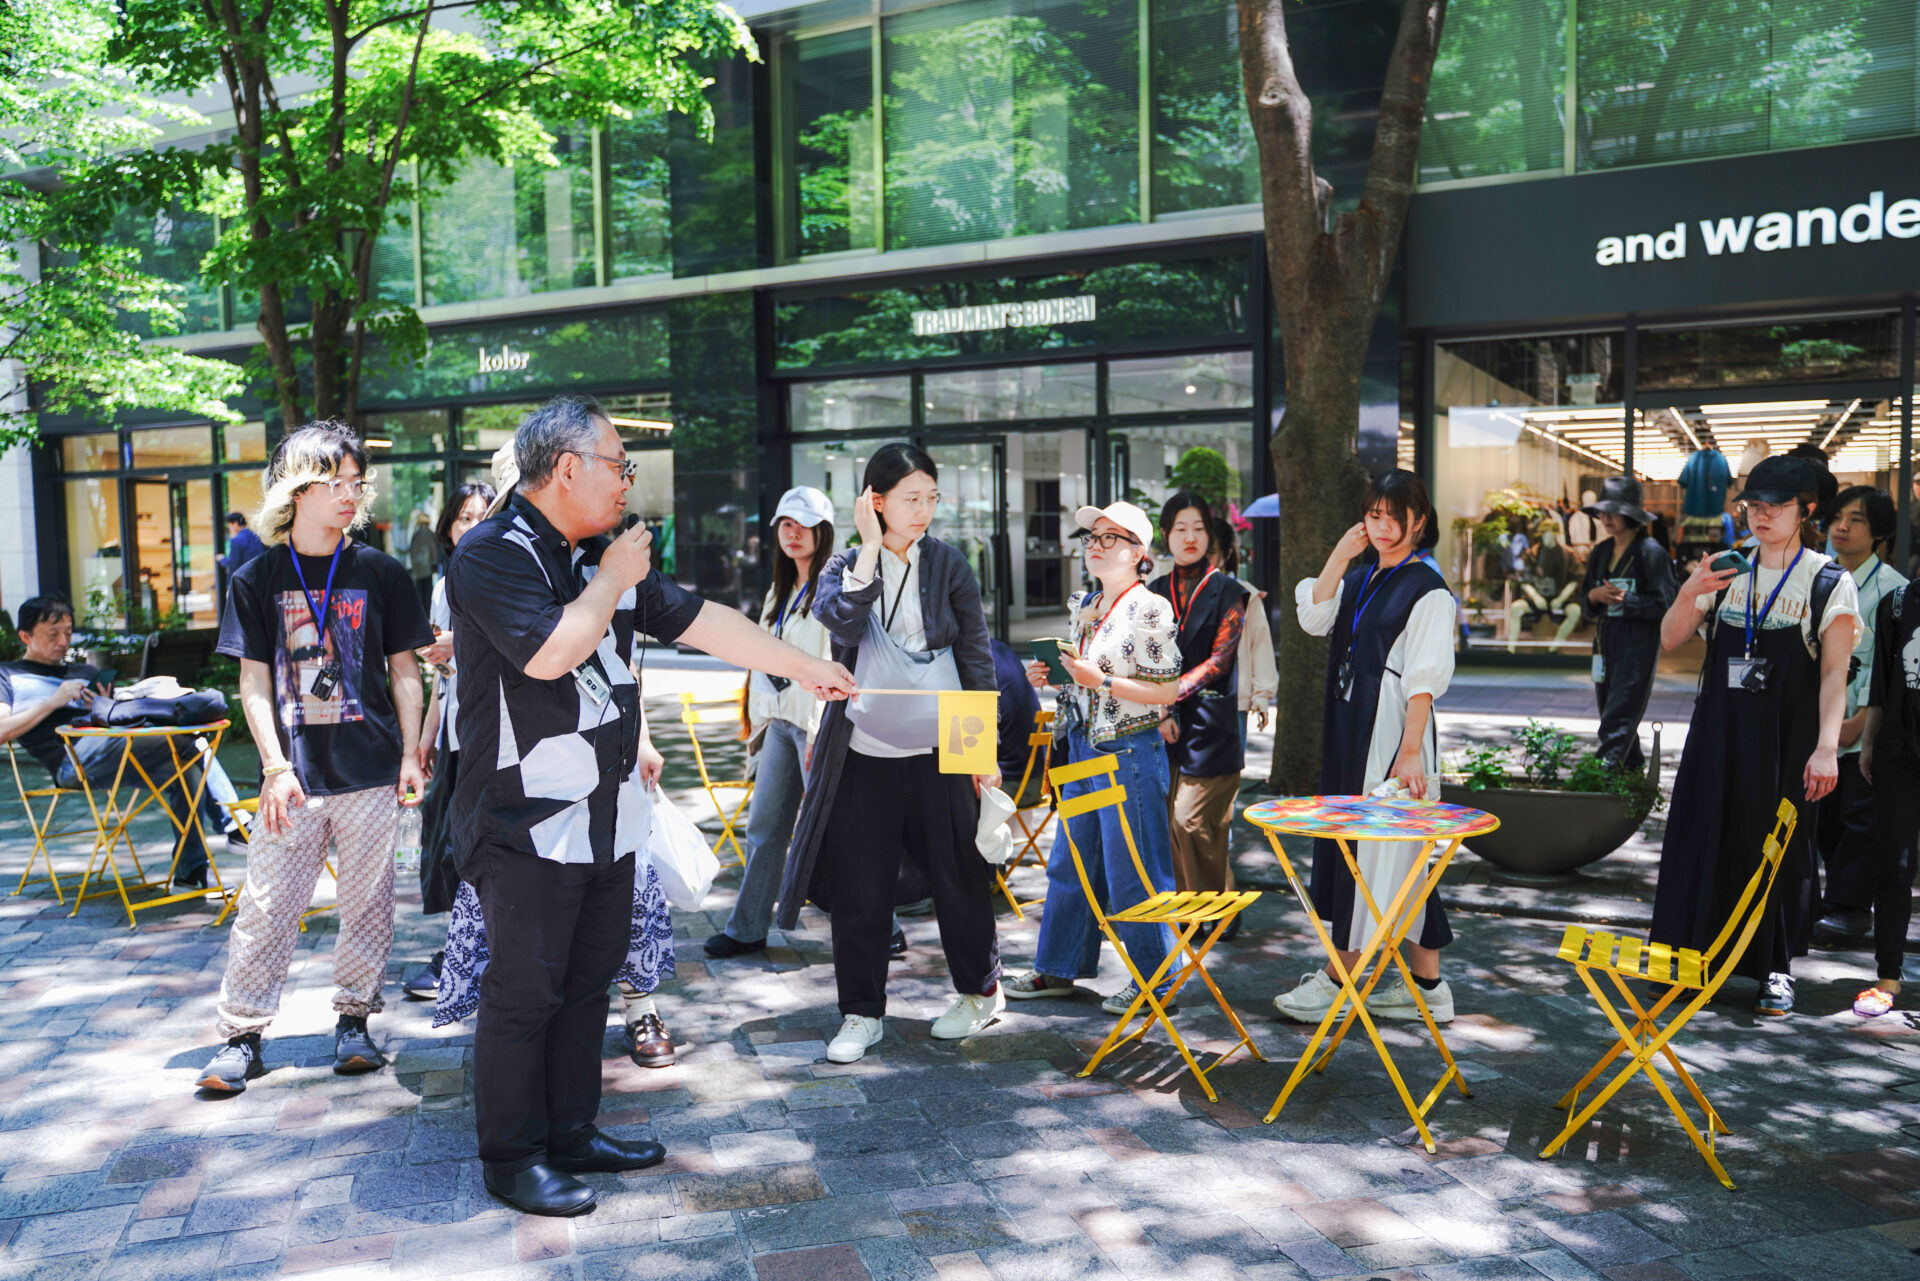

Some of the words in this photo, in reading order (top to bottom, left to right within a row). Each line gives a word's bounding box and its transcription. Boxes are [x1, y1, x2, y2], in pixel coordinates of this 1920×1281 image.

[1596, 222, 1686, 266] and
[1699, 190, 1920, 256] wande
[478, 344, 530, 373] kolor
